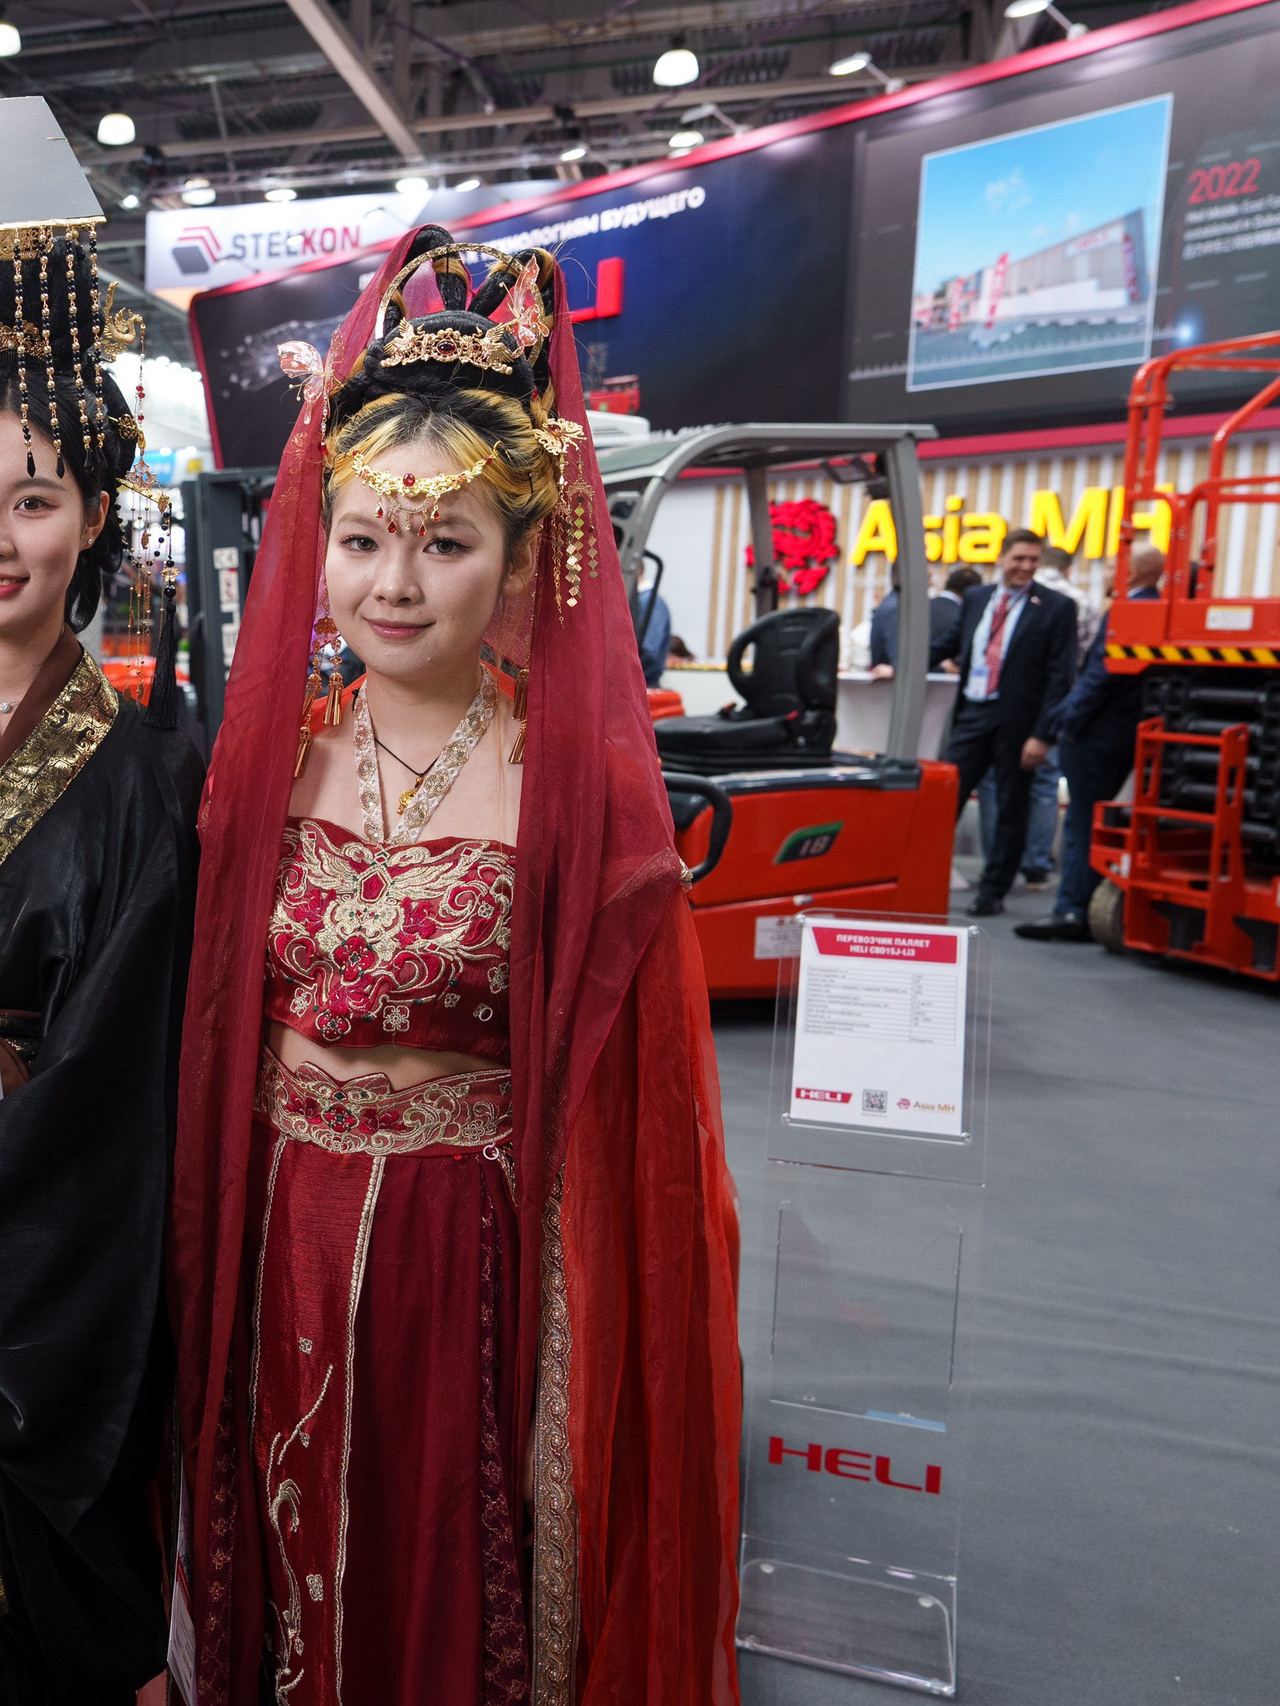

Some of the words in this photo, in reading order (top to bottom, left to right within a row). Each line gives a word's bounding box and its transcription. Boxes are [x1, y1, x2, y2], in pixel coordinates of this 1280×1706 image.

[1187, 157, 1261, 205] 2022
[600, 186, 706, 233] БУДУЩЕГО
[232, 224, 362, 260] STELKON
[848, 494, 1007, 566] Asia
[1028, 482, 1175, 559] MH
[799, 834, 831, 857] 18
[836, 934, 893, 946] ПЕРЕВОЗЧИК
[894, 938, 931, 948] ПАЛЛЕТ
[850, 945, 868, 954] HELI
[800, 1089, 842, 1102] HELI
[914, 1101, 935, 1111] Asia
[937, 1103, 956, 1113] MH
[768, 1436, 943, 1495] HELI
